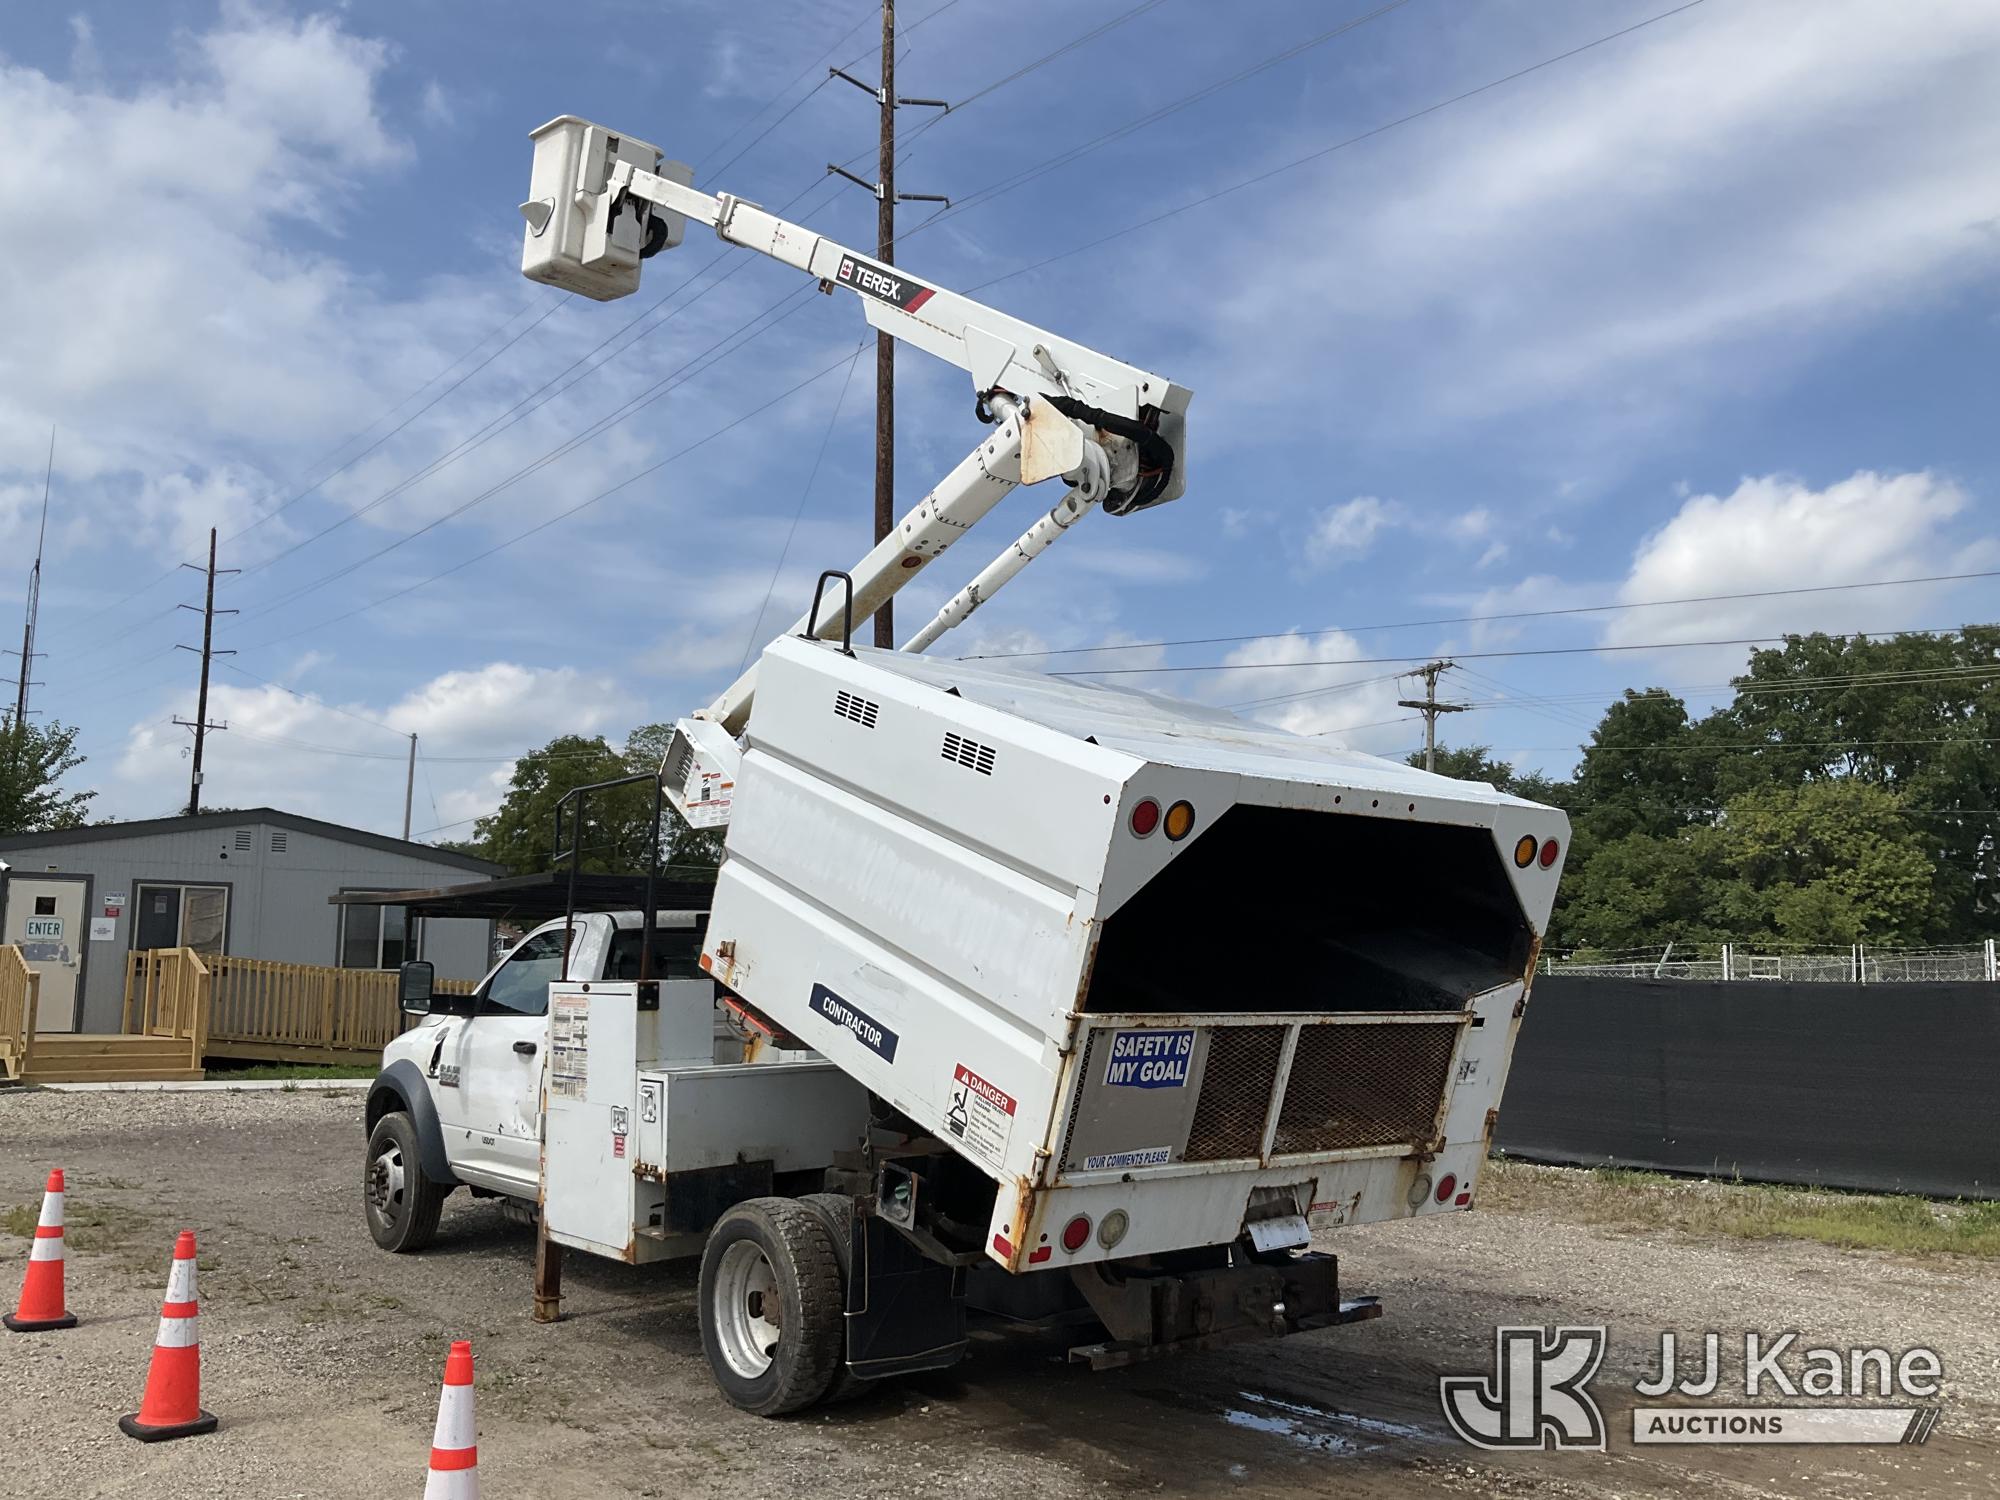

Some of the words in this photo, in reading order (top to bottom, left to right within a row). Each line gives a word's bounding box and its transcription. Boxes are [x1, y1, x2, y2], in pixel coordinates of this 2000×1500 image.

[856, 266, 901, 300] TEREX
[28, 921, 61, 936] ENTER
[823, 996, 882, 1048] CONTRACTOR
[1114, 1035, 1175, 1057] SAFETY
[1175, 1034, 1191, 1055] IS
[1109, 1062, 1138, 1083] MY
[1139, 1060, 1185, 1082] GOAL
[970, 1076, 1008, 1110] DANGER
[976, 1094, 991, 1107] FALLING
[992, 1105, 1006, 1117] OBJECT
[1088, 1156, 1106, 1168] YOUR
[1107, 1153, 1143, 1167] COMMENTS
[1144, 1151, 1169, 1164] PLEASE
